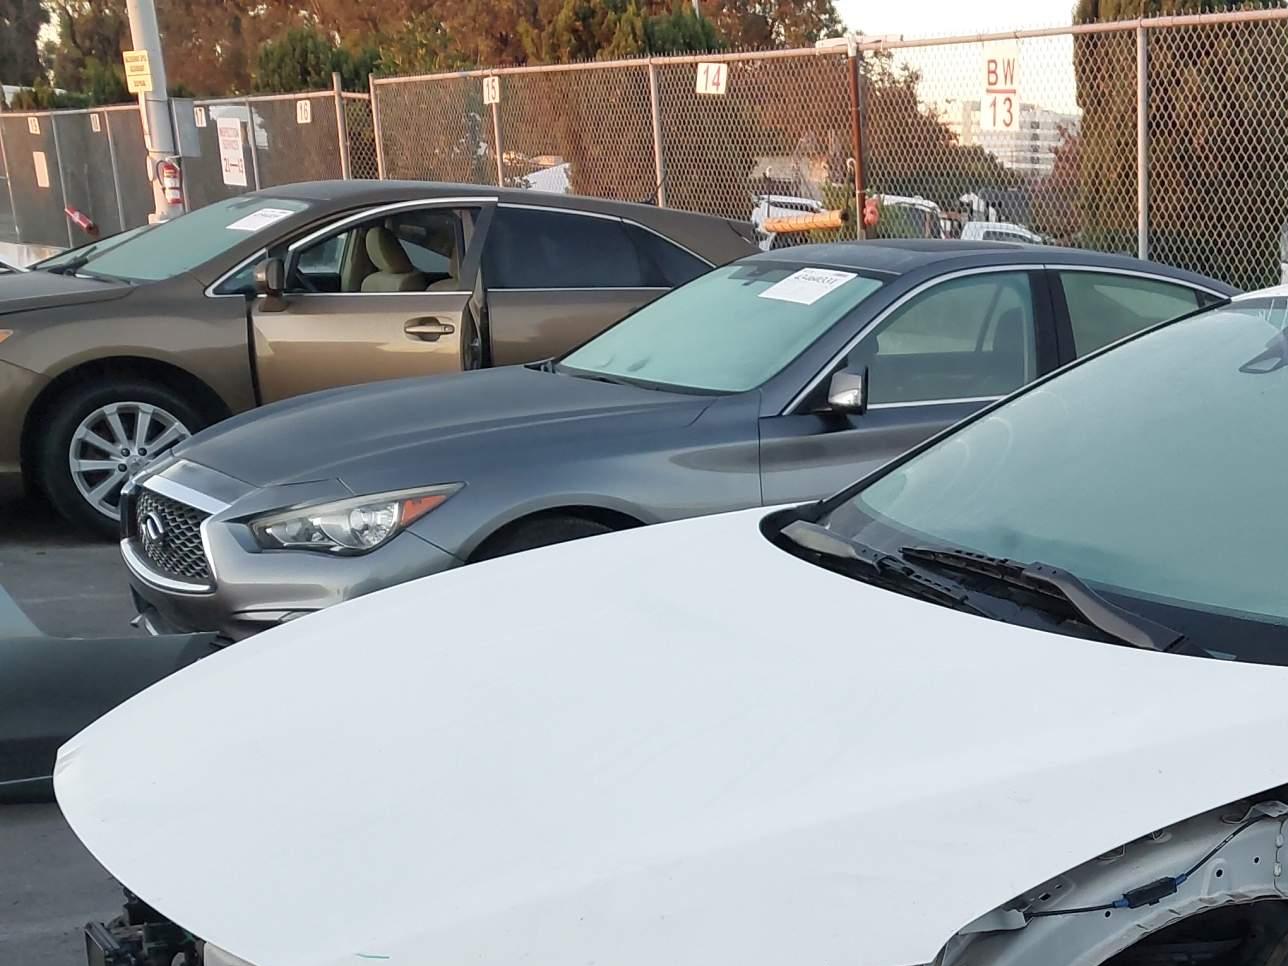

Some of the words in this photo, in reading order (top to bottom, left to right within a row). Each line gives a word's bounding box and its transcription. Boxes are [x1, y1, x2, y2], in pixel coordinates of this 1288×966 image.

[486, 78, 497, 102] 15
[703, 65, 721, 92] 14
[989, 95, 1014, 128] 13
